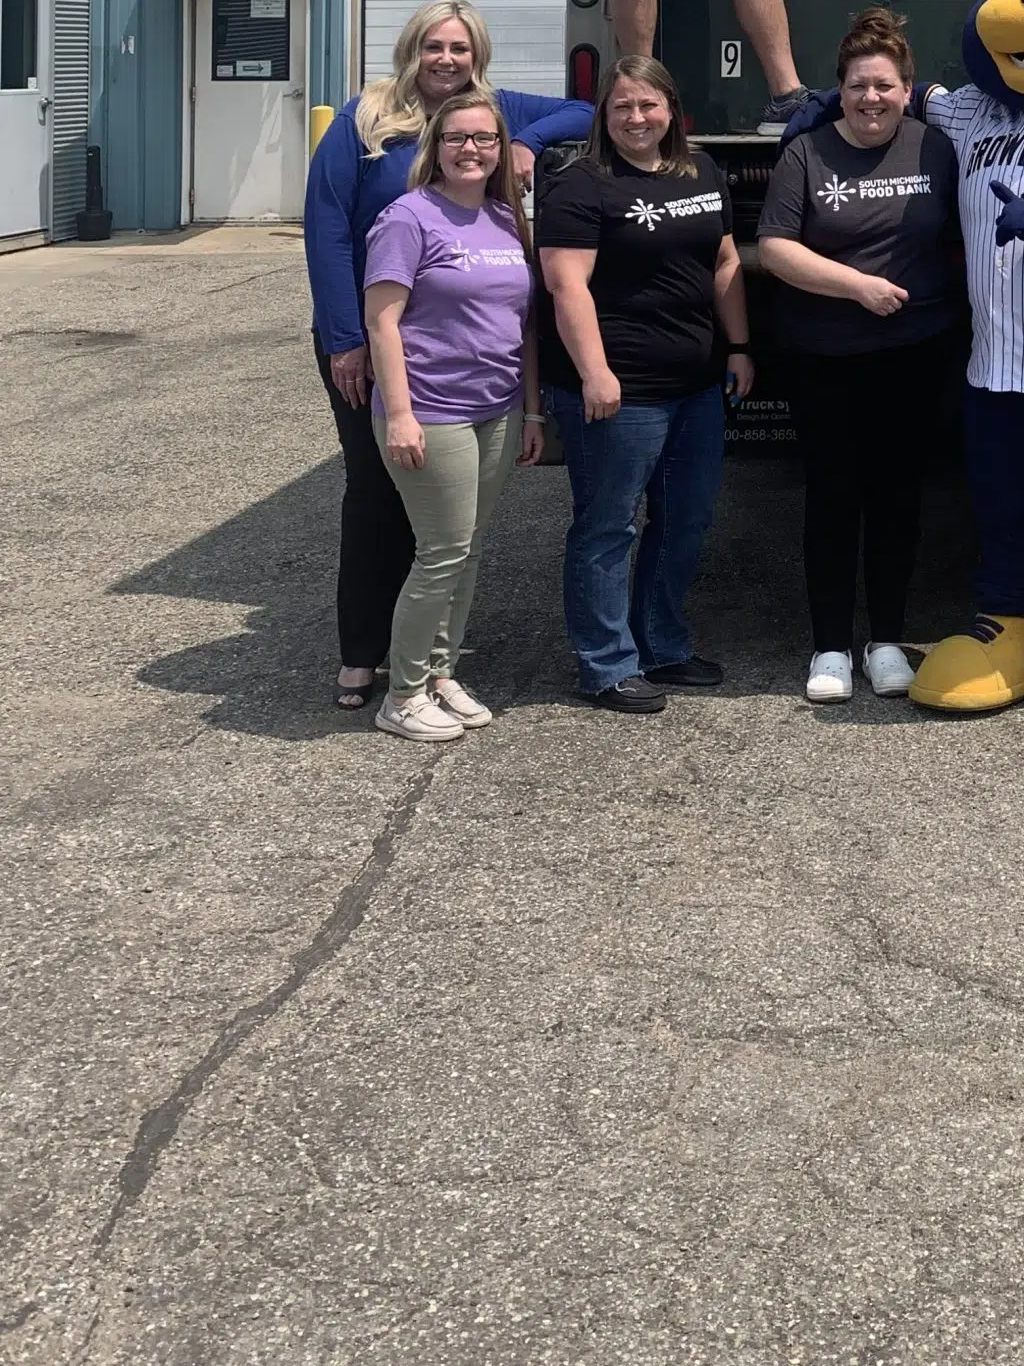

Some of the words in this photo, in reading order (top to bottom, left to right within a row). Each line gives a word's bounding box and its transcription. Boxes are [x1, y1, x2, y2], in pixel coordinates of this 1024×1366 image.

[724, 43, 739, 75] 9
[858, 177, 888, 189] SOUTH
[889, 174, 931, 186] MICHIGAN
[860, 186, 894, 199] FOOD
[896, 183, 932, 196] BANK
[664, 197, 692, 210] SOUTH
[690, 191, 721, 204] MICHIGAN
[668, 203, 702, 218] FOOD
[483, 256, 512, 266] FOOD
